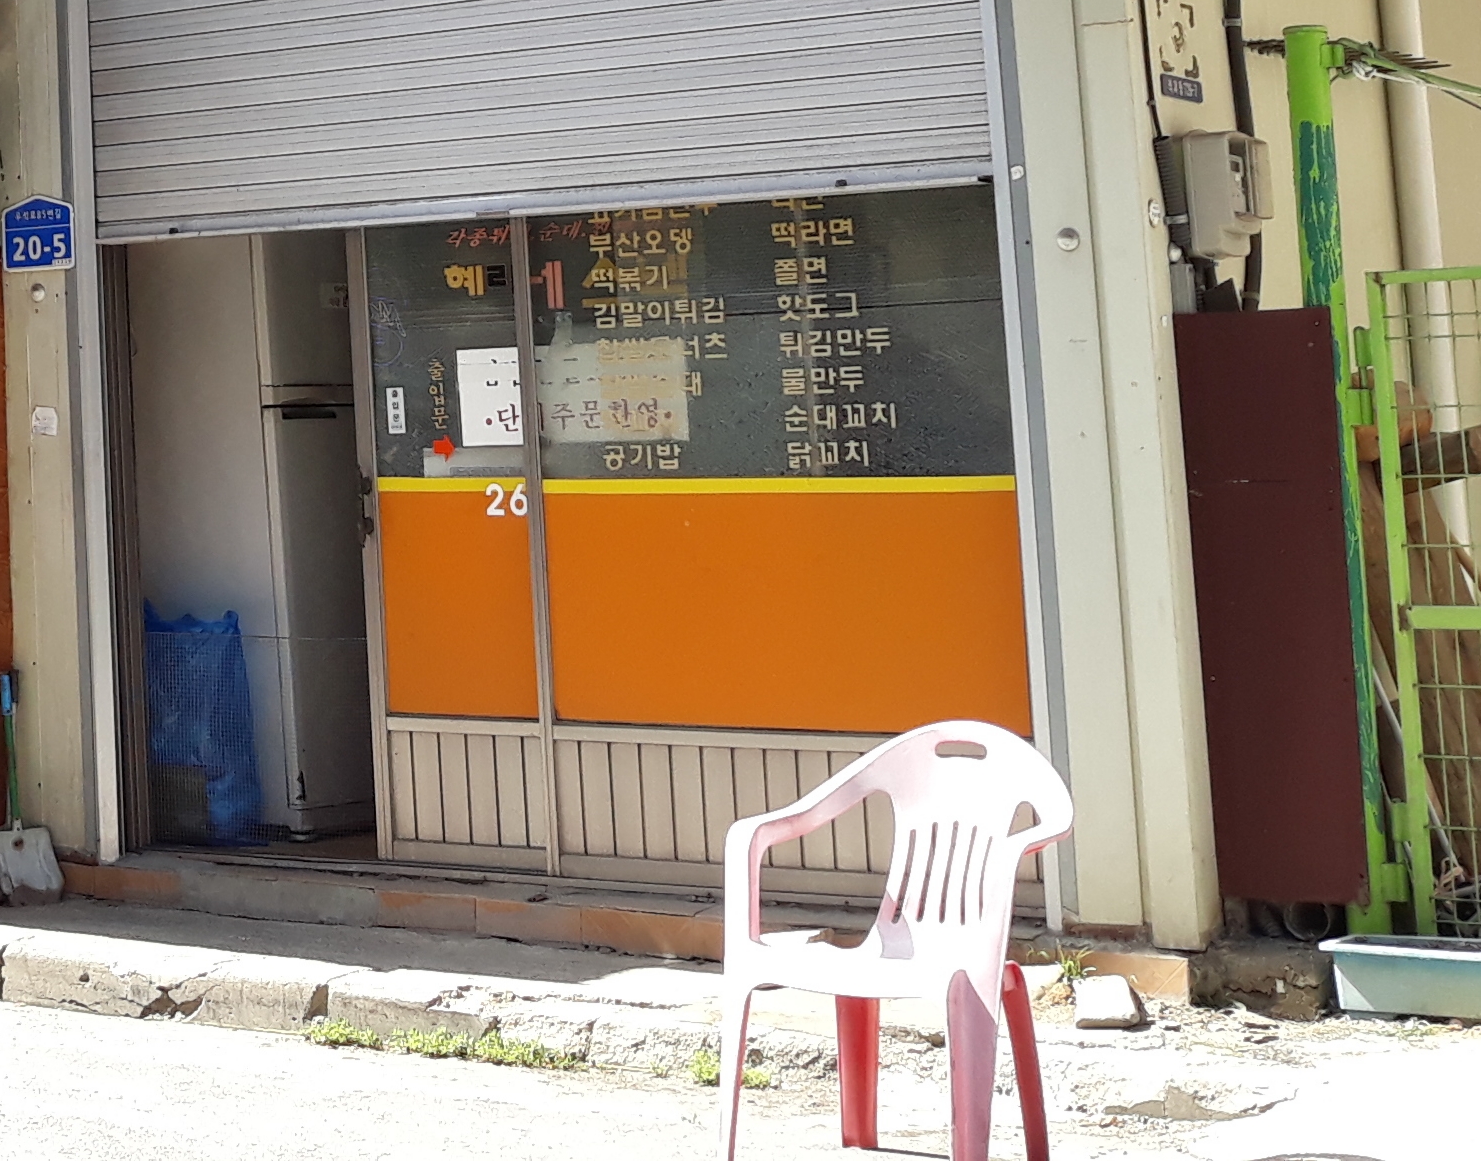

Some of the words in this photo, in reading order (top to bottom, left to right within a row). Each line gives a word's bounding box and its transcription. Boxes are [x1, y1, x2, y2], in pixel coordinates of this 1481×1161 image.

[12, 233, 66, 262] 20-5
[446, 225, 512, 248] 각종튀
[589, 228, 693, 258] 부산오뎅
[771, 217, 855, 249] 떡라면
[590, 265, 668, 294] 떡볶기
[774, 256, 828, 286] 쫄면
[593, 296, 726, 330] 김말이튀김
[776, 292, 859, 322] 핫도그
[779, 327, 891, 358] 튀김만두
[428, 359, 449, 430] 출입문
[781, 365, 865, 396] 물만두
[785, 401, 897, 432] 순대꼬치
[602, 443, 682, 471] 공기밥
[787, 440, 870, 470] 닭꼬치
[485, 484, 528, 517] 26
